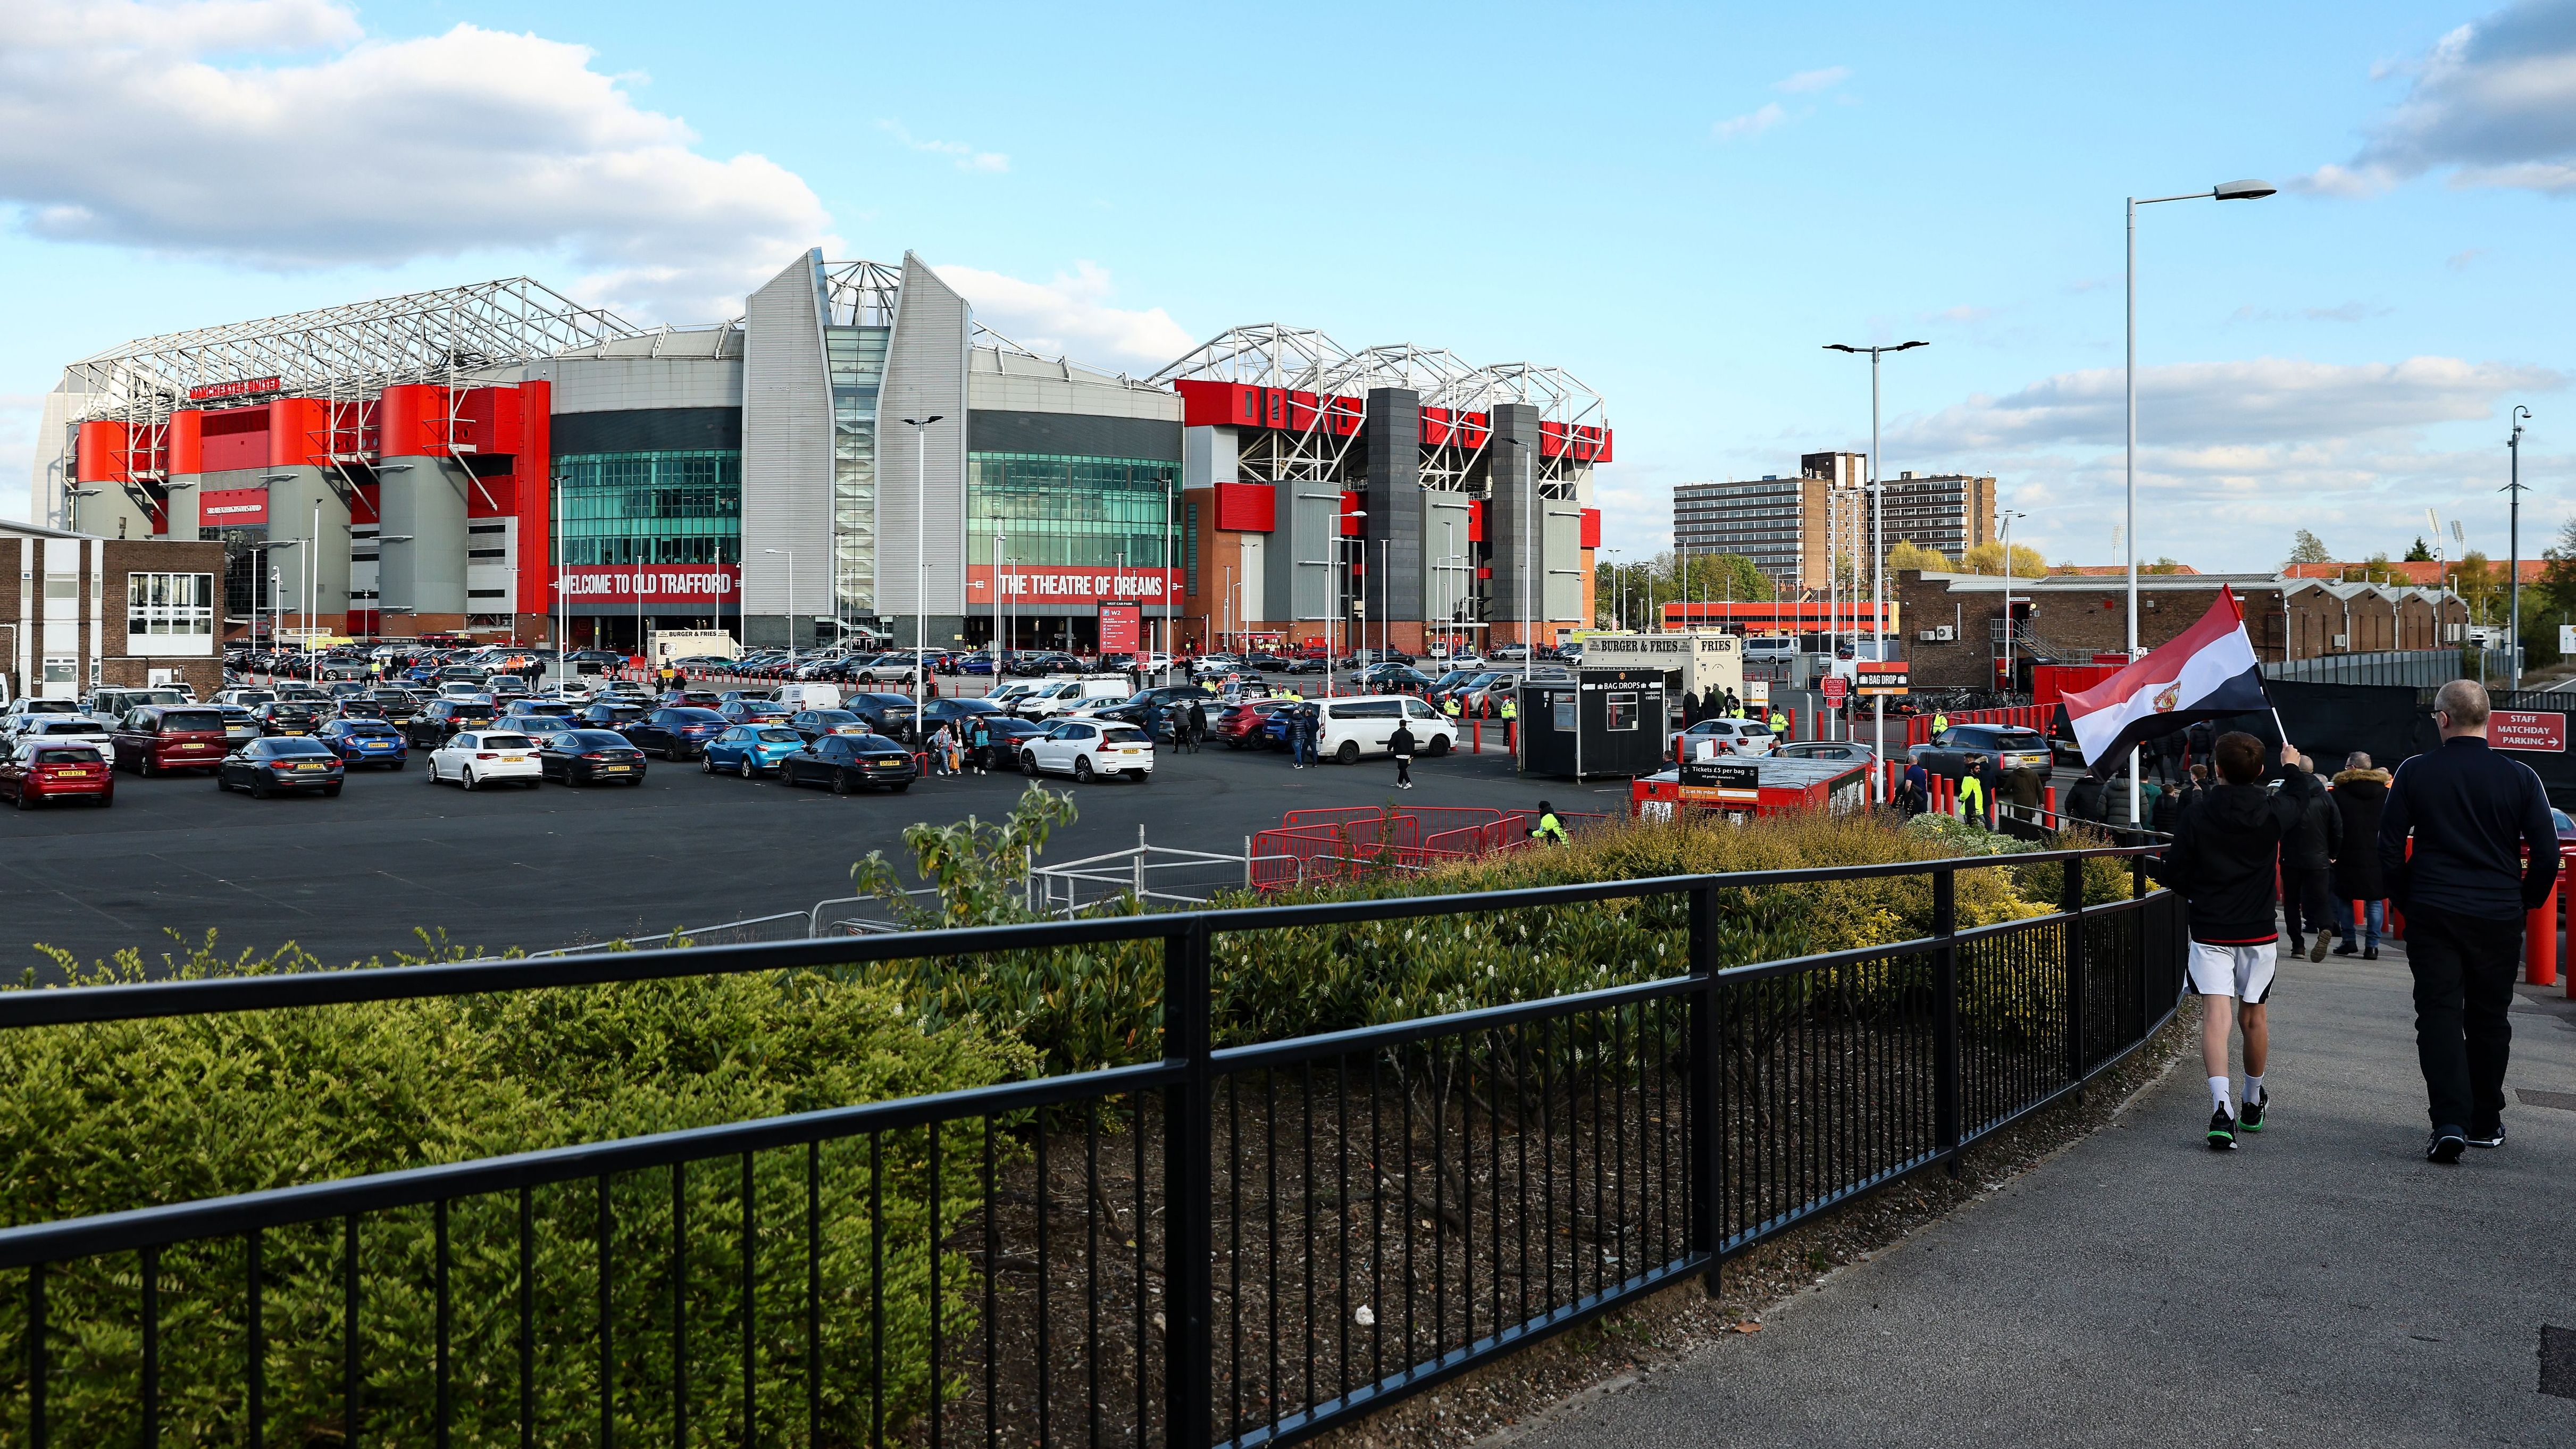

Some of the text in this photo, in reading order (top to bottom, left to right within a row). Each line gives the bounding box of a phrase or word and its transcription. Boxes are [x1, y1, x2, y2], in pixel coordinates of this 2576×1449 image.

[190, 378, 280, 399] MANCHESTER UNITED
[562, 574, 731, 594] WELCOME TO OLD TRAFFORD
[1000, 574, 1162, 596] THE THEATRE OF DREAMS
[1601, 640, 1678, 652] BURGER & FRIES
[1701, 640, 1730, 652] FRIES
[1869, 675, 1896, 684] BAG DROP
[2497, 725, 2550, 734] MATCHDAY
[2503, 736, 2544, 745] PARKING
